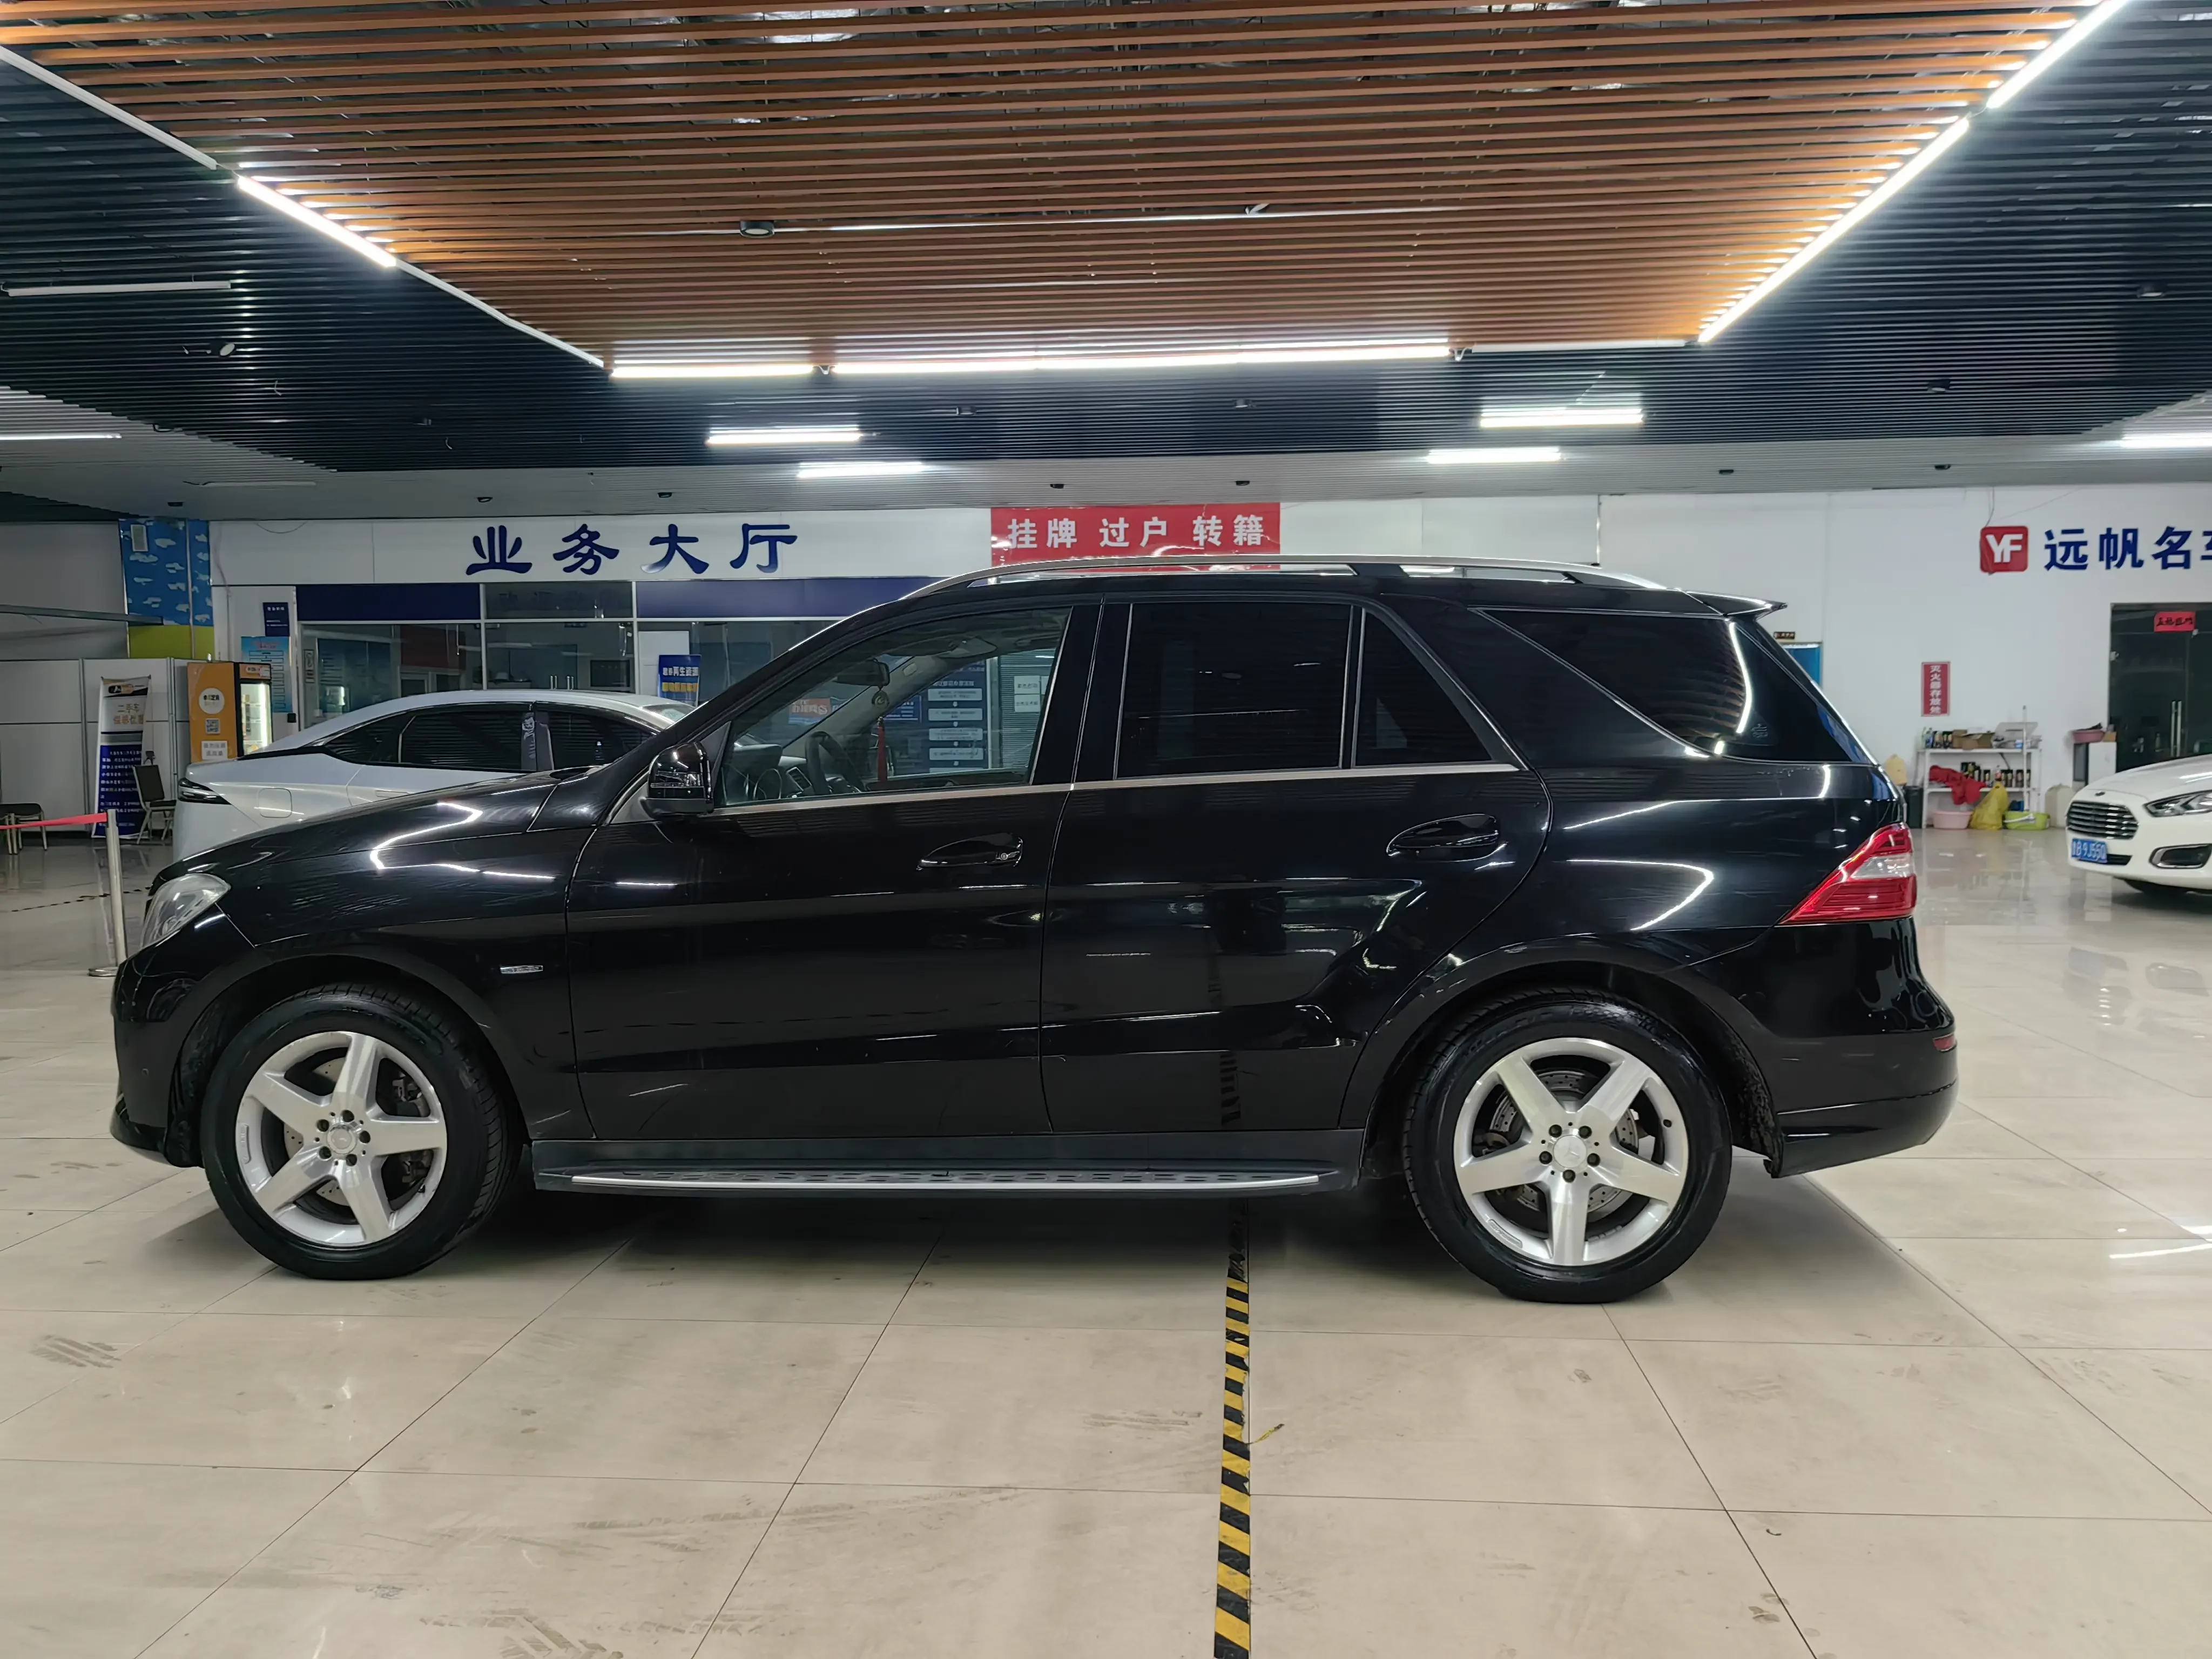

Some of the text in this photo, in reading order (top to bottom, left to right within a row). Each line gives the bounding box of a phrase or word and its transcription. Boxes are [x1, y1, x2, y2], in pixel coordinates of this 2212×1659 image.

[1008, 515, 1264, 548] 挂牌 过户 转籍
[466, 523, 798, 576] 业务大厅
[1986, 534, 2023, 563] YF
